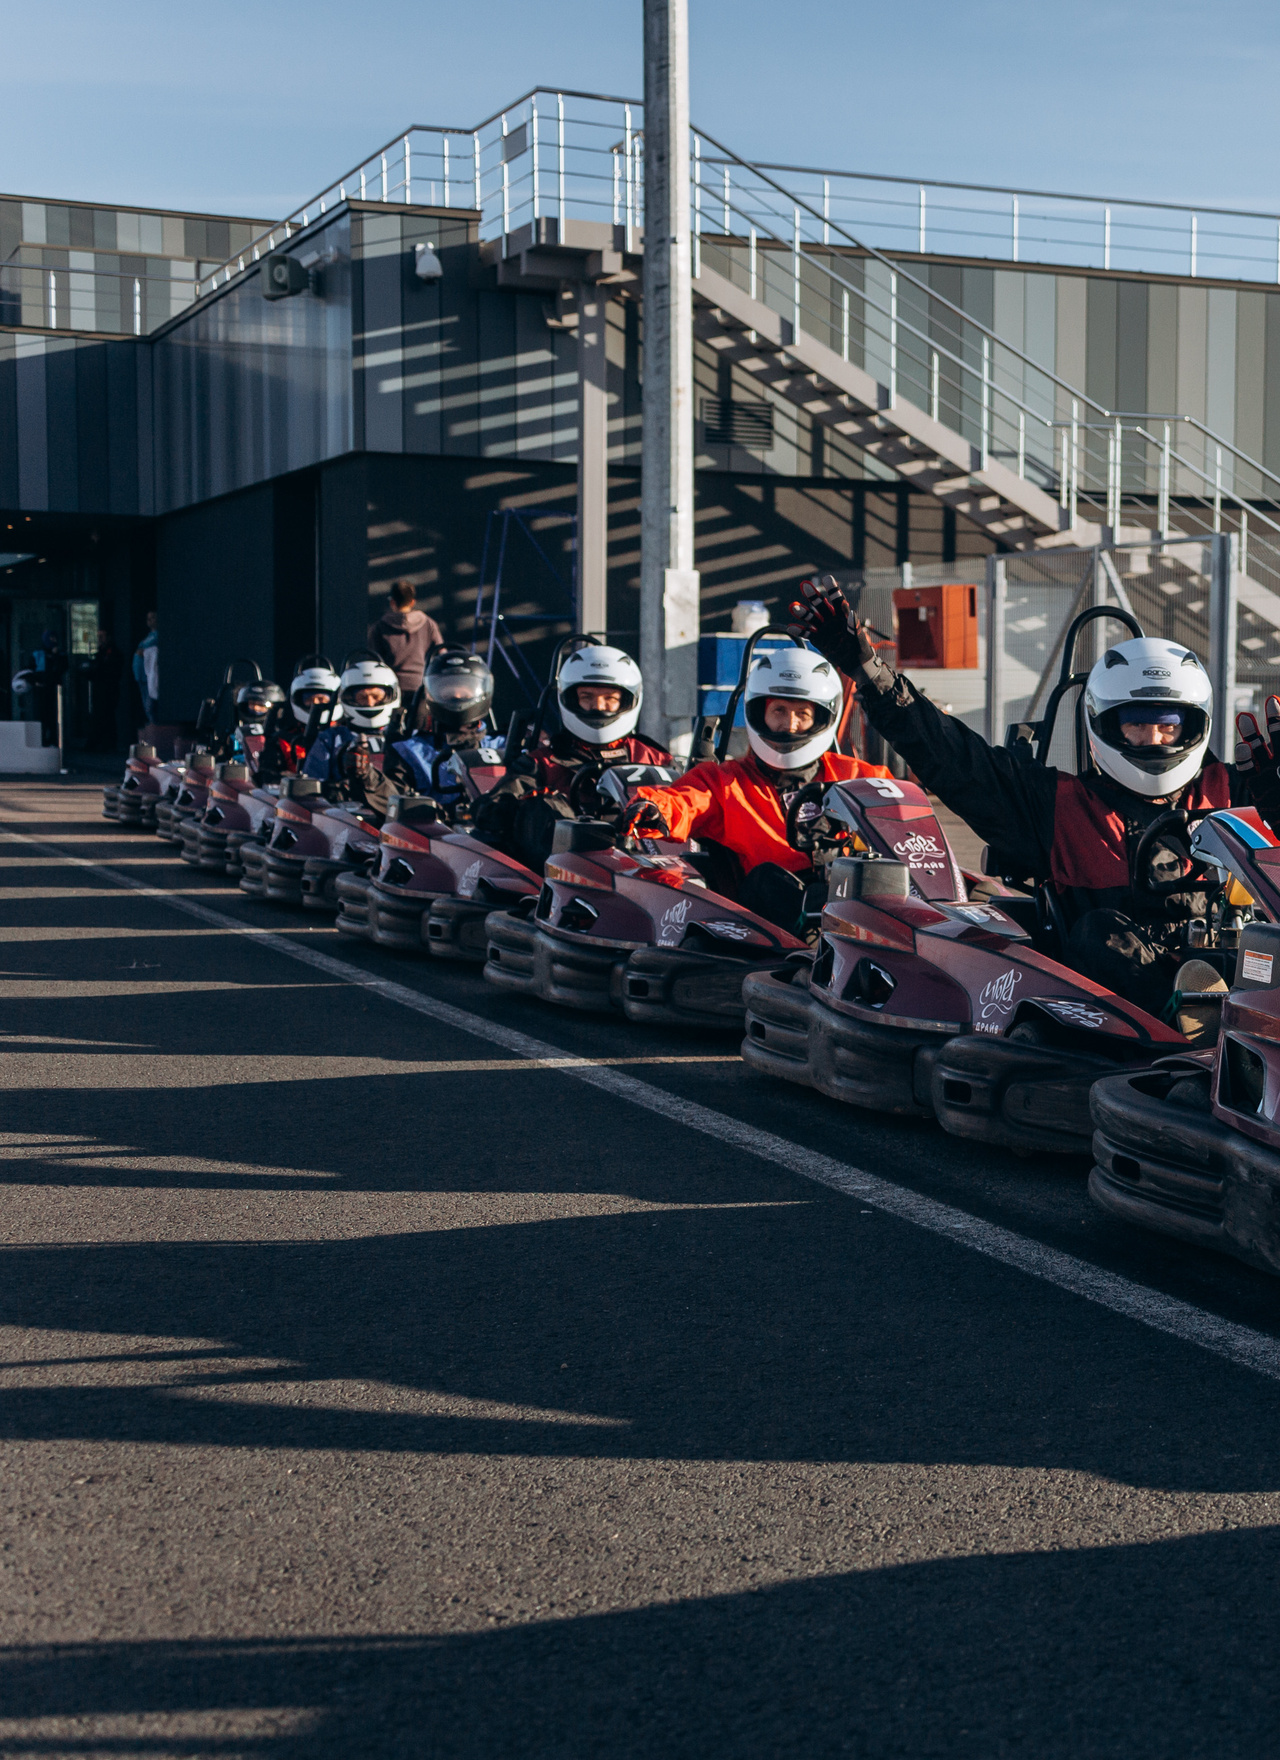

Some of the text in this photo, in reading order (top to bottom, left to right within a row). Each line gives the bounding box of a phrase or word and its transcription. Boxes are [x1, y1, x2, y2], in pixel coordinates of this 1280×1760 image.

[249, 723, 264, 735] 3
[477, 748, 502, 764] 8
[622, 765, 673, 782] 21
[865, 778, 905, 799] 9
